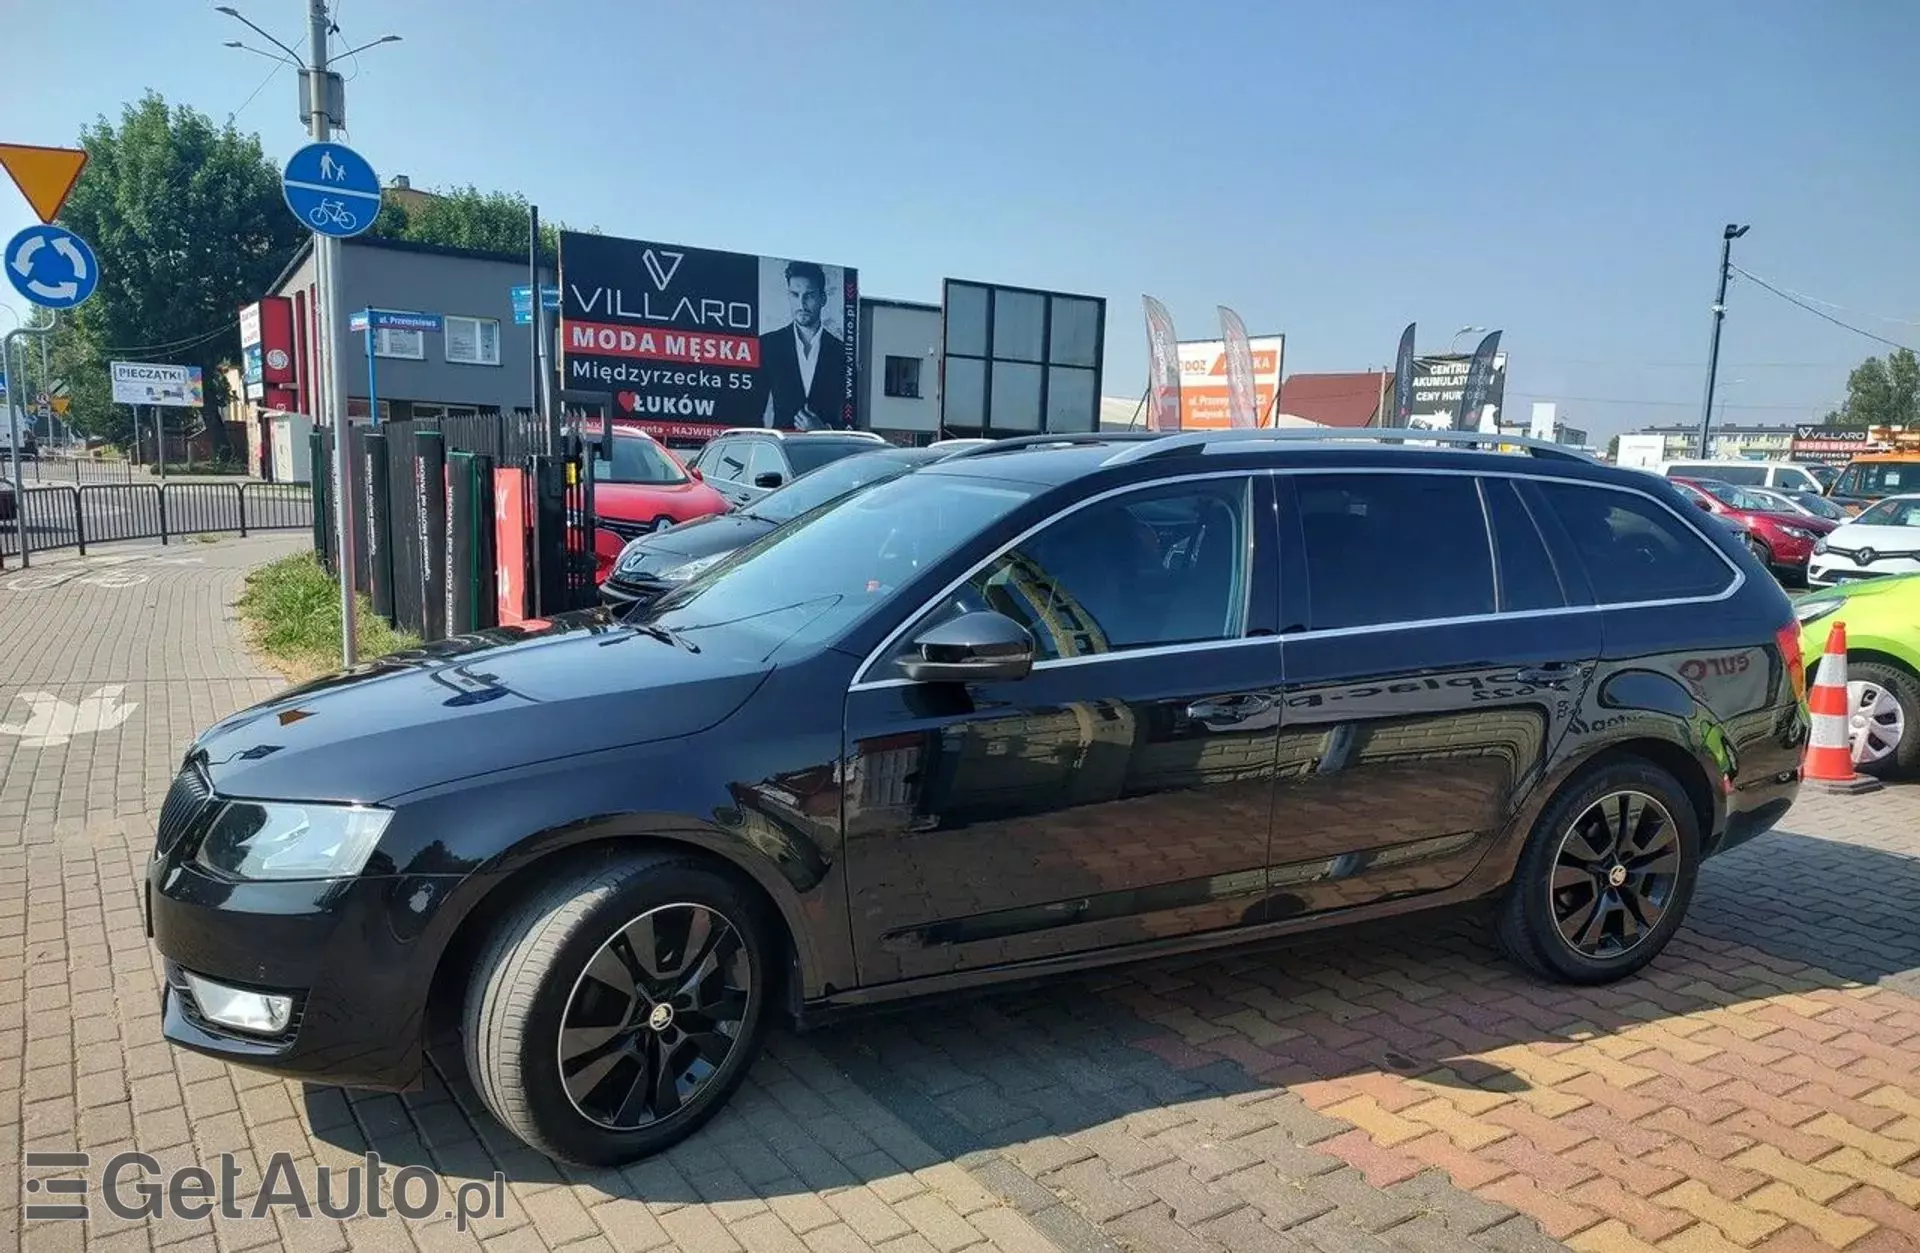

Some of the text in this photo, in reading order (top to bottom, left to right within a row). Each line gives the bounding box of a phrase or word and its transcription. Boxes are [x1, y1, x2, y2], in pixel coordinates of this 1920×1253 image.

[571, 283, 751, 329] VILLARO
[572, 325, 752, 363] MODA MĘSKA
[844, 304, 856, 399] www.villaro.pl
[572, 360, 753, 391] Międzyrzecka 55
[633, 392, 715, 417] ŁUKÓW
[1416, 391, 1439, 401] CENY
[1811, 431, 1865, 440] VILLARO
